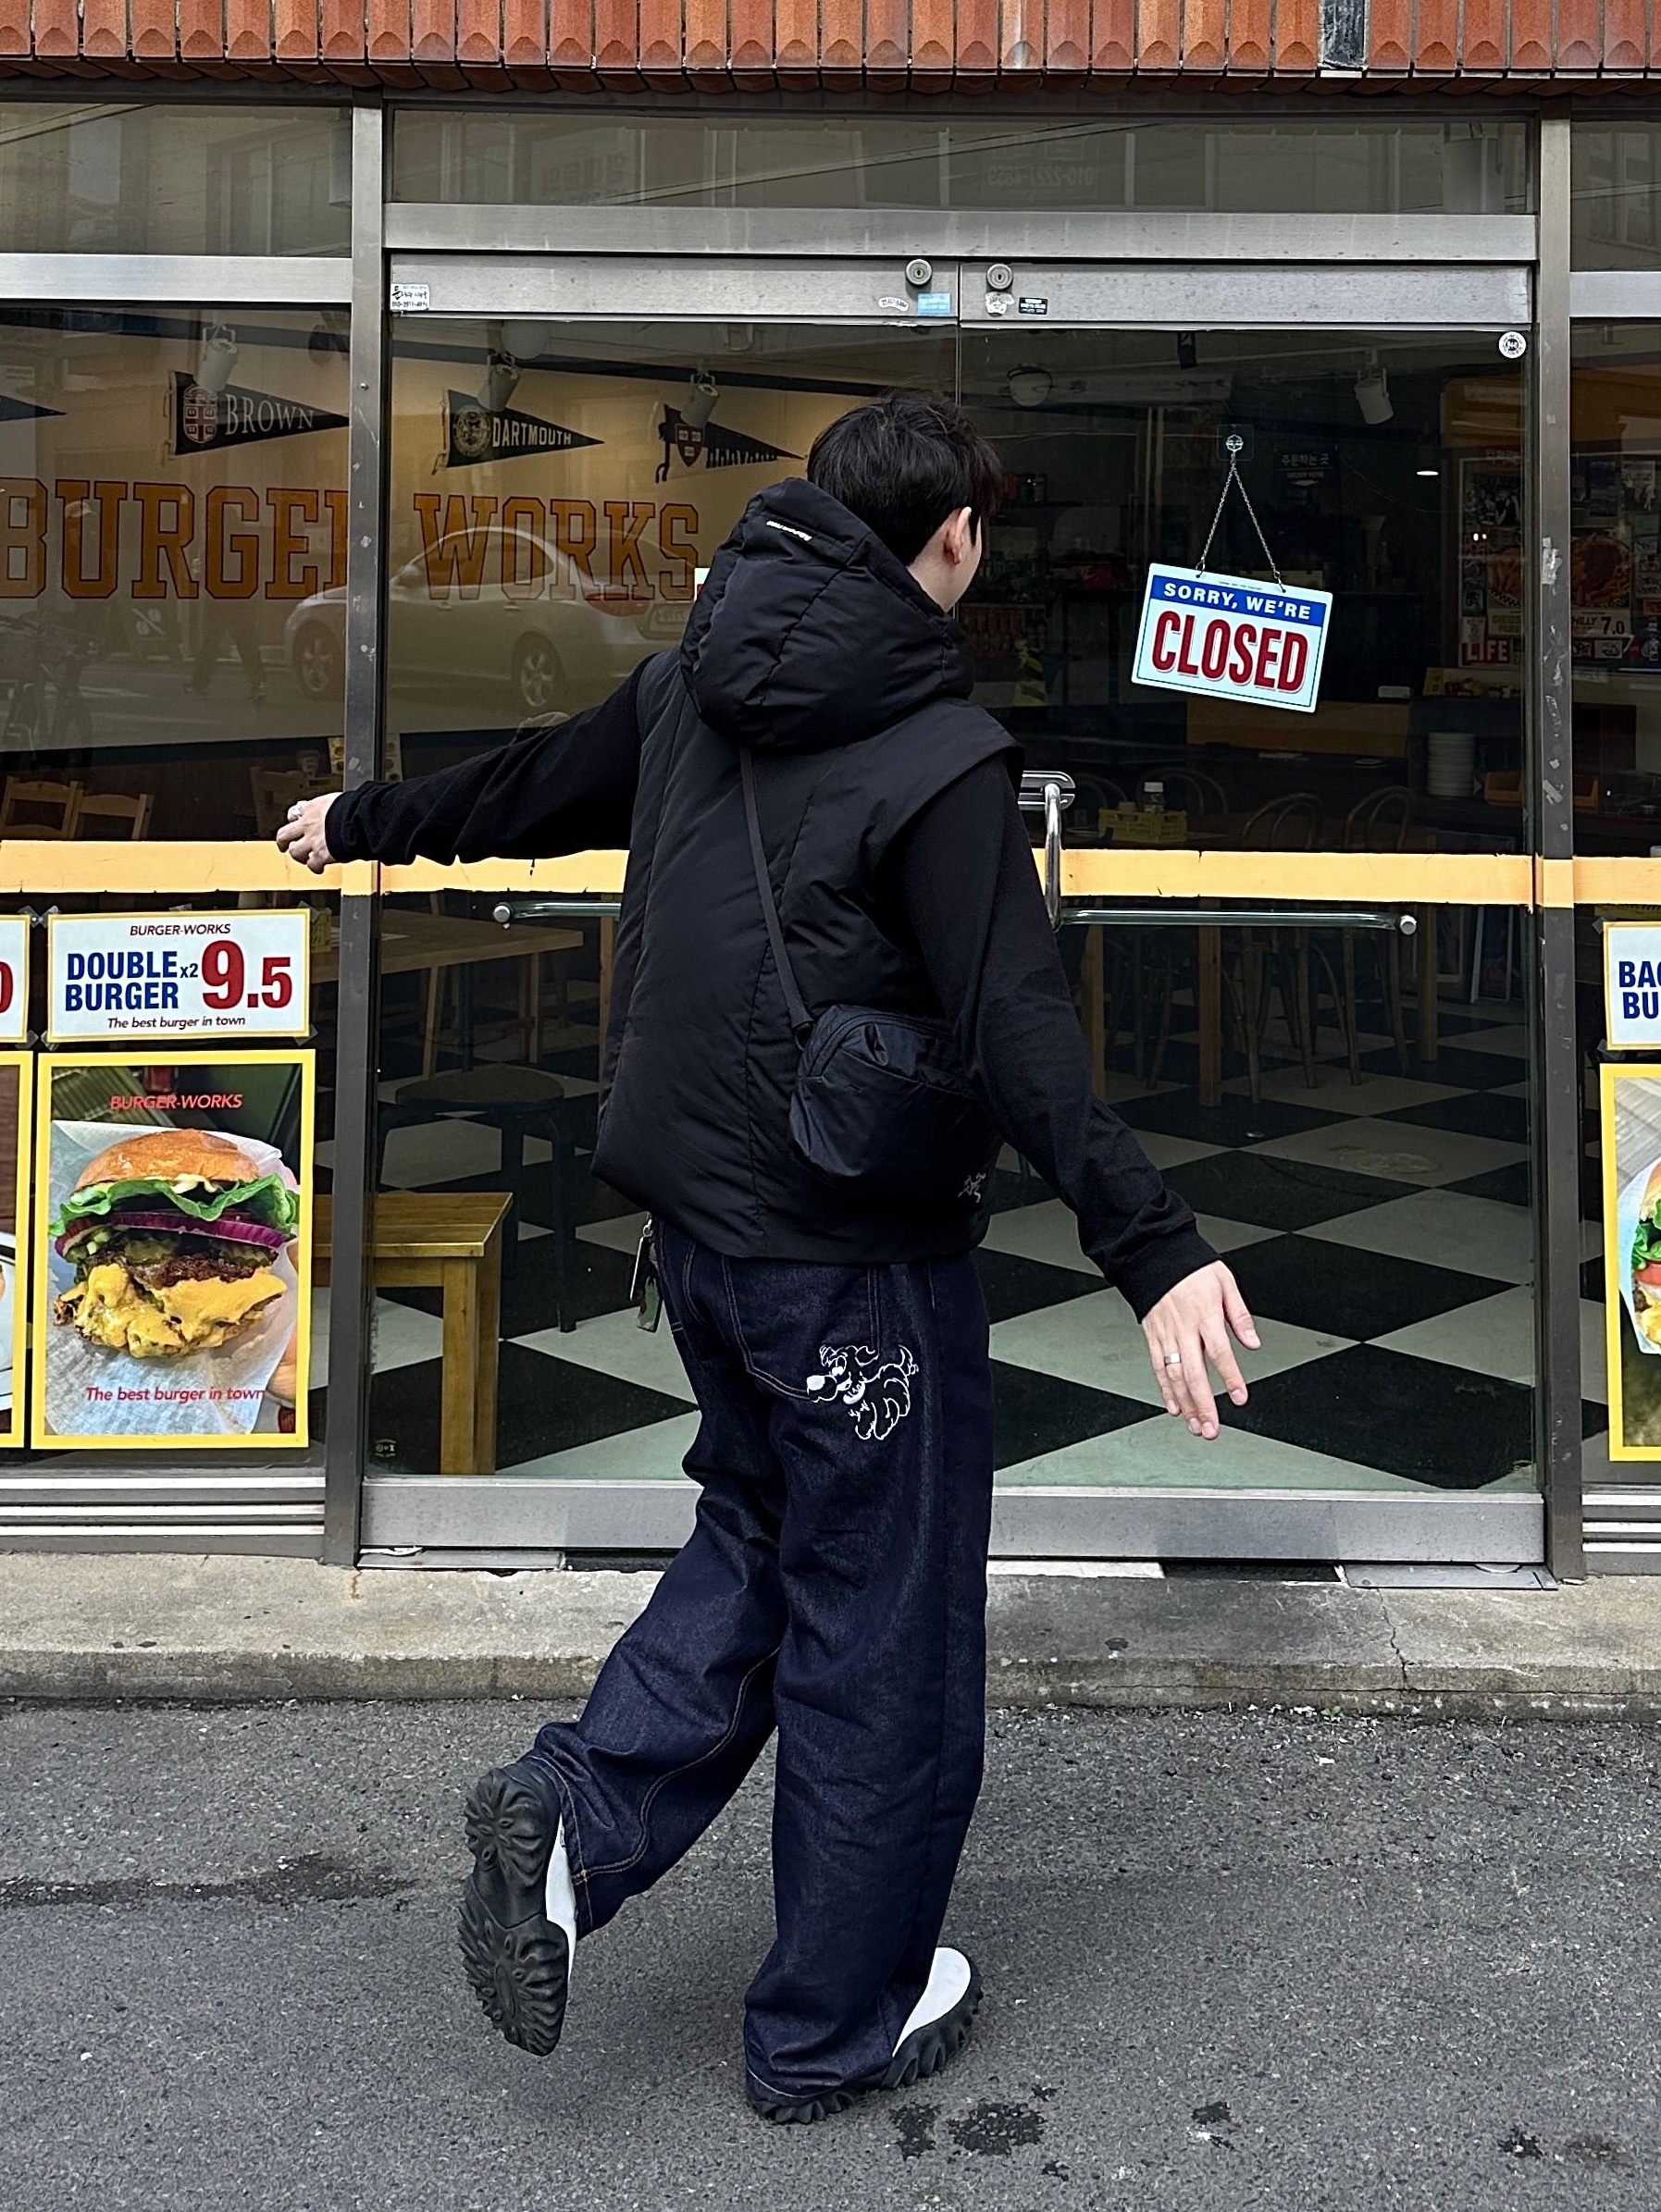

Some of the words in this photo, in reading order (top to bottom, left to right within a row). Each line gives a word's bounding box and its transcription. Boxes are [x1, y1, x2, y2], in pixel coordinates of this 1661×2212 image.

[225, 393, 316, 436] BROWN
[491, 416, 573, 448] DARTMOUTH
[0, 478, 348, 599] BURGE
[414, 493, 700, 601] WORKS
[1163, 582, 1238, 610] SORRY,
[1246, 595, 1312, 620] WE'RE
[1601, 615, 1626, 636] 7.0
[1151, 610, 1309, 693] CLOSED
[1466, 639, 1510, 661] LIFE
[130, 923, 231, 937] BURGER-WORKS
[67, 950, 178, 981] DOUBLE
[180, 962, 199, 979] x2
[201, 939, 293, 1009] 9.5
[65, 982, 179, 1012] BURGER
[107, 1017, 130, 1029] The
[131, 1017, 157, 1029] best
[159, 1016, 200, 1031] burger
[202, 1015, 214, 1027] in
[215, 1016, 246, 1027] town
[109, 1094, 243, 1110] BURGER-WORKS
[85, 1387, 114, 1403] The
[117, 1387, 150, 1402] best
[154, 1387, 204, 1404] burger
[209, 1387, 222, 1400] in
[226, 1388, 266, 1401] town
